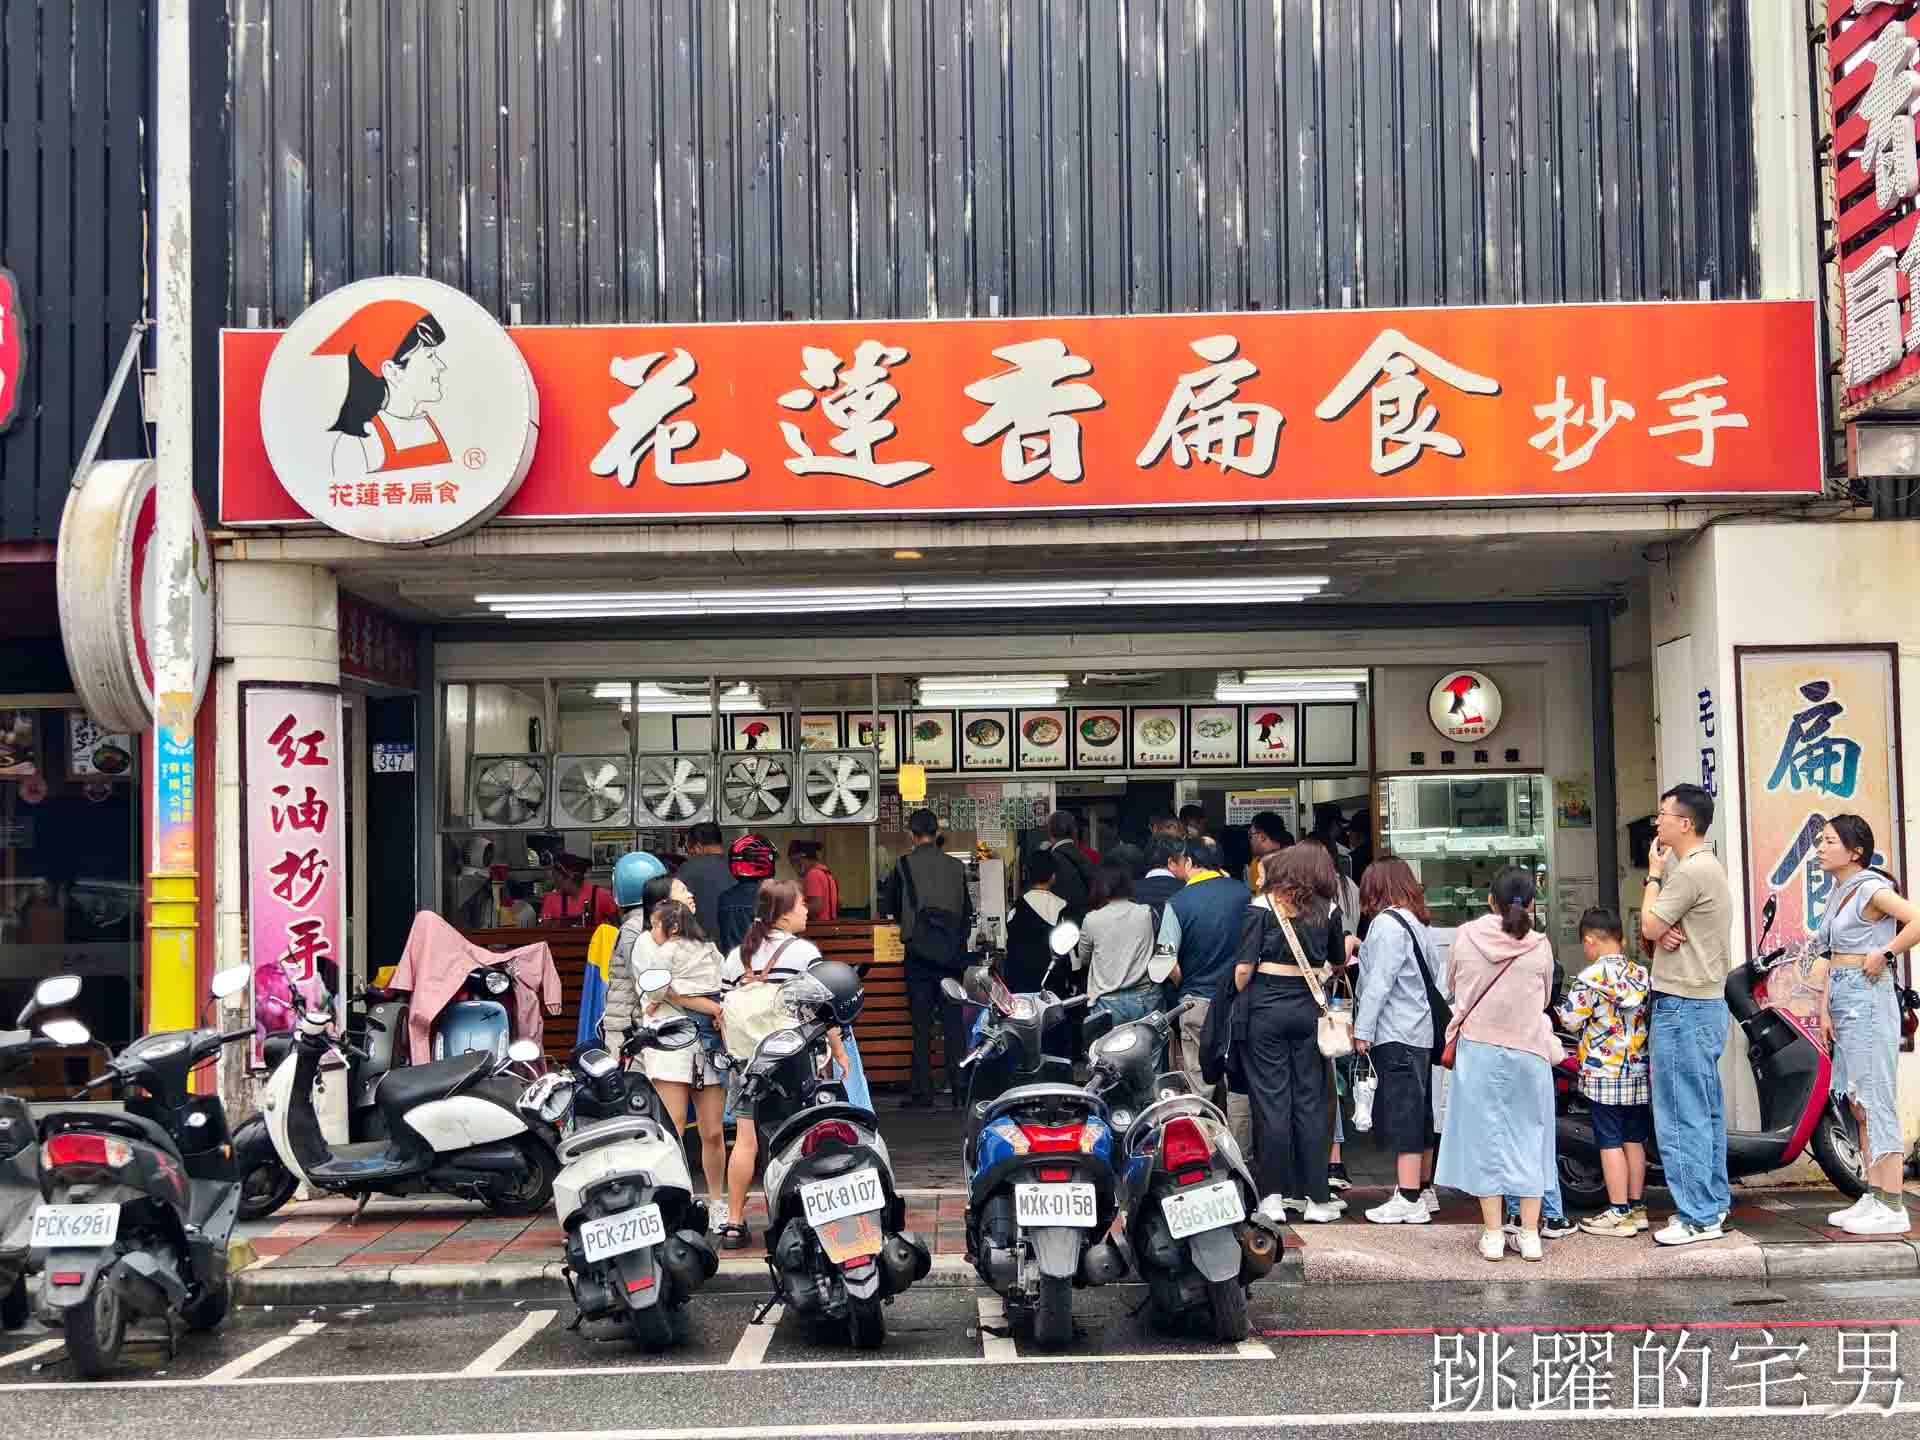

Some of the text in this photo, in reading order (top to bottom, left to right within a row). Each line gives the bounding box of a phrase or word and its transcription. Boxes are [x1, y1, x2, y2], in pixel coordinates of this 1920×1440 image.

[589, 328, 1749, 488] 花蓮香扁食 抄手
[328, 481, 460, 507] 花蓮香扁食
[379, 754, 405, 771] 347
[267, 713, 329, 982] 紅油抄手
